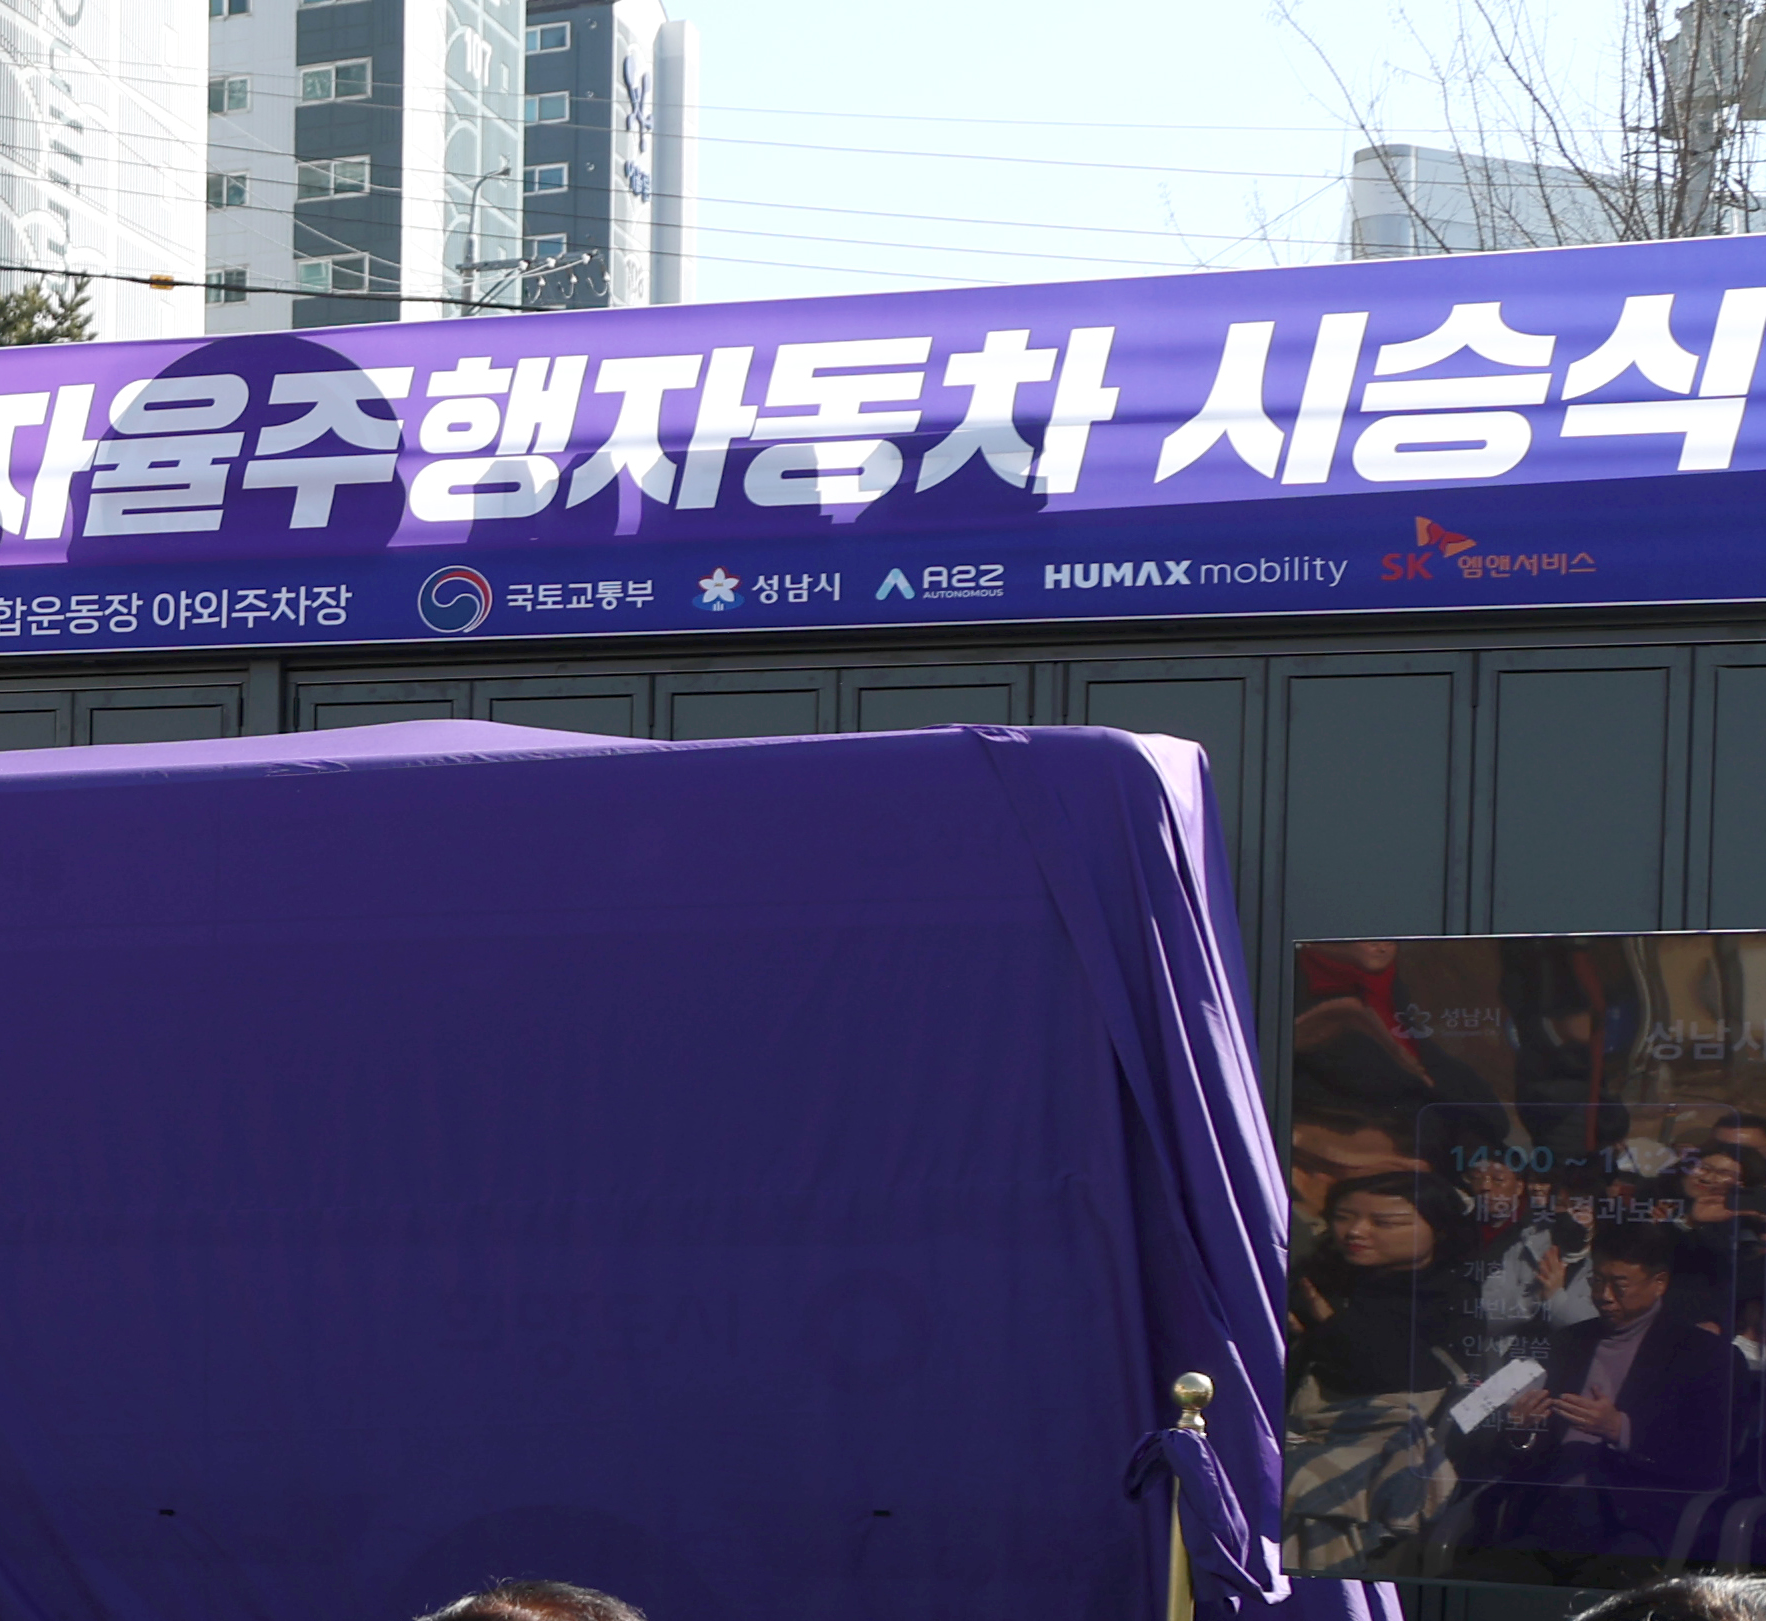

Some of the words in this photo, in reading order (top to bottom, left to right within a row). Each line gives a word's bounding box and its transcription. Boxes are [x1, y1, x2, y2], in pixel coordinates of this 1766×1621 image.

[464, 27, 492, 87] 107
[1154, 287, 1766, 486] 시승식
[1044, 559, 1192, 590] HUMAX
[1199, 555, 1349, 588] mobility
[1380, 551, 1434, 582] SK
[1457, 551, 1597, 579] 엠앤서비스
[505, 578, 655, 612] 국토교통부
[750, 571, 842, 603] 성남시
[922, 588, 1005, 599] AUTONOMOUS
[151, 584, 354, 633] 야외주차장
[1441, 1008, 1501, 1028] 성남시
[1646, 1019, 1766, 1061] 성남시
[1451, 1145, 1554, 1173] 14:00
[1530, 1194, 1557, 1223] 및
[1568, 1195, 1686, 1225] 경과보고
